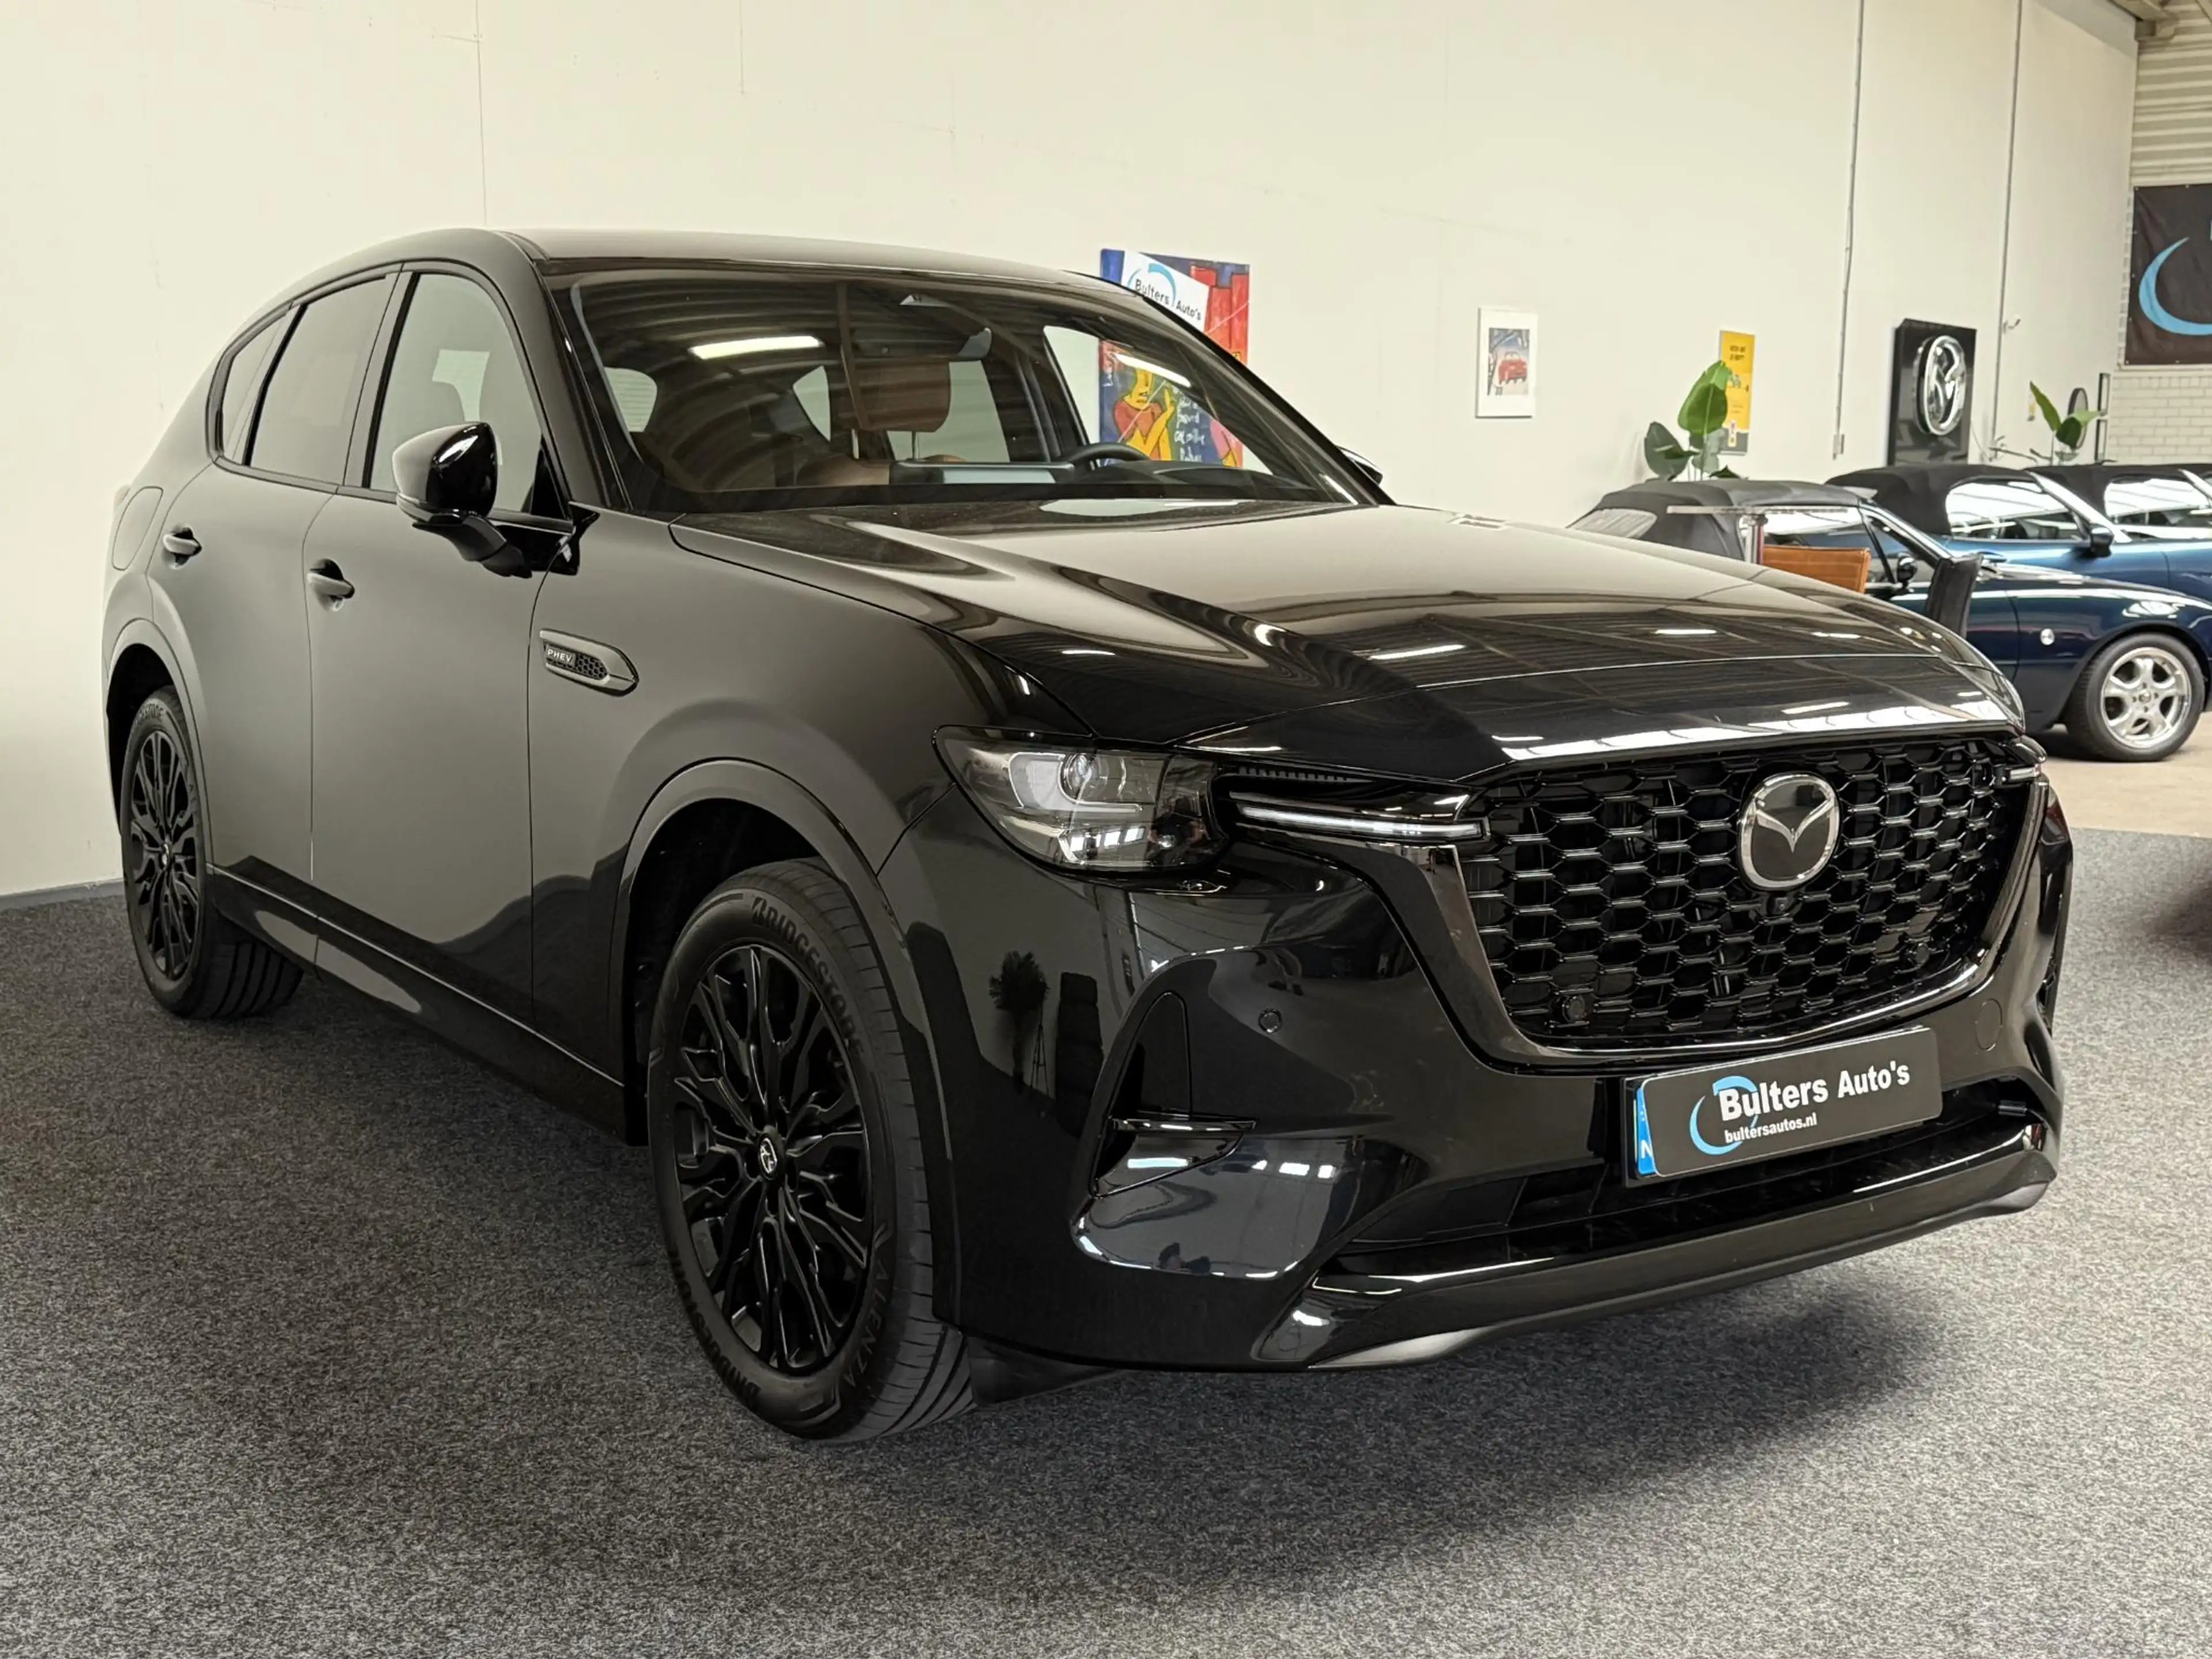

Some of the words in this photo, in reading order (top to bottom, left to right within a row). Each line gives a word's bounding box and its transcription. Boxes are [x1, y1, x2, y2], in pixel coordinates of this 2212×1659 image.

[1135, 278, 1170, 305] Bulters
[1176, 300, 1202, 320] Auto's
[547, 648, 572, 662] PHEV
[751, 896, 865, 1058] BRIDGESTONE
[1718, 1078, 1828, 1121] Bulters
[1838, 1060, 1911, 1099] Auto's
[1724, 1112, 1817, 1144] bultersautos.nl
